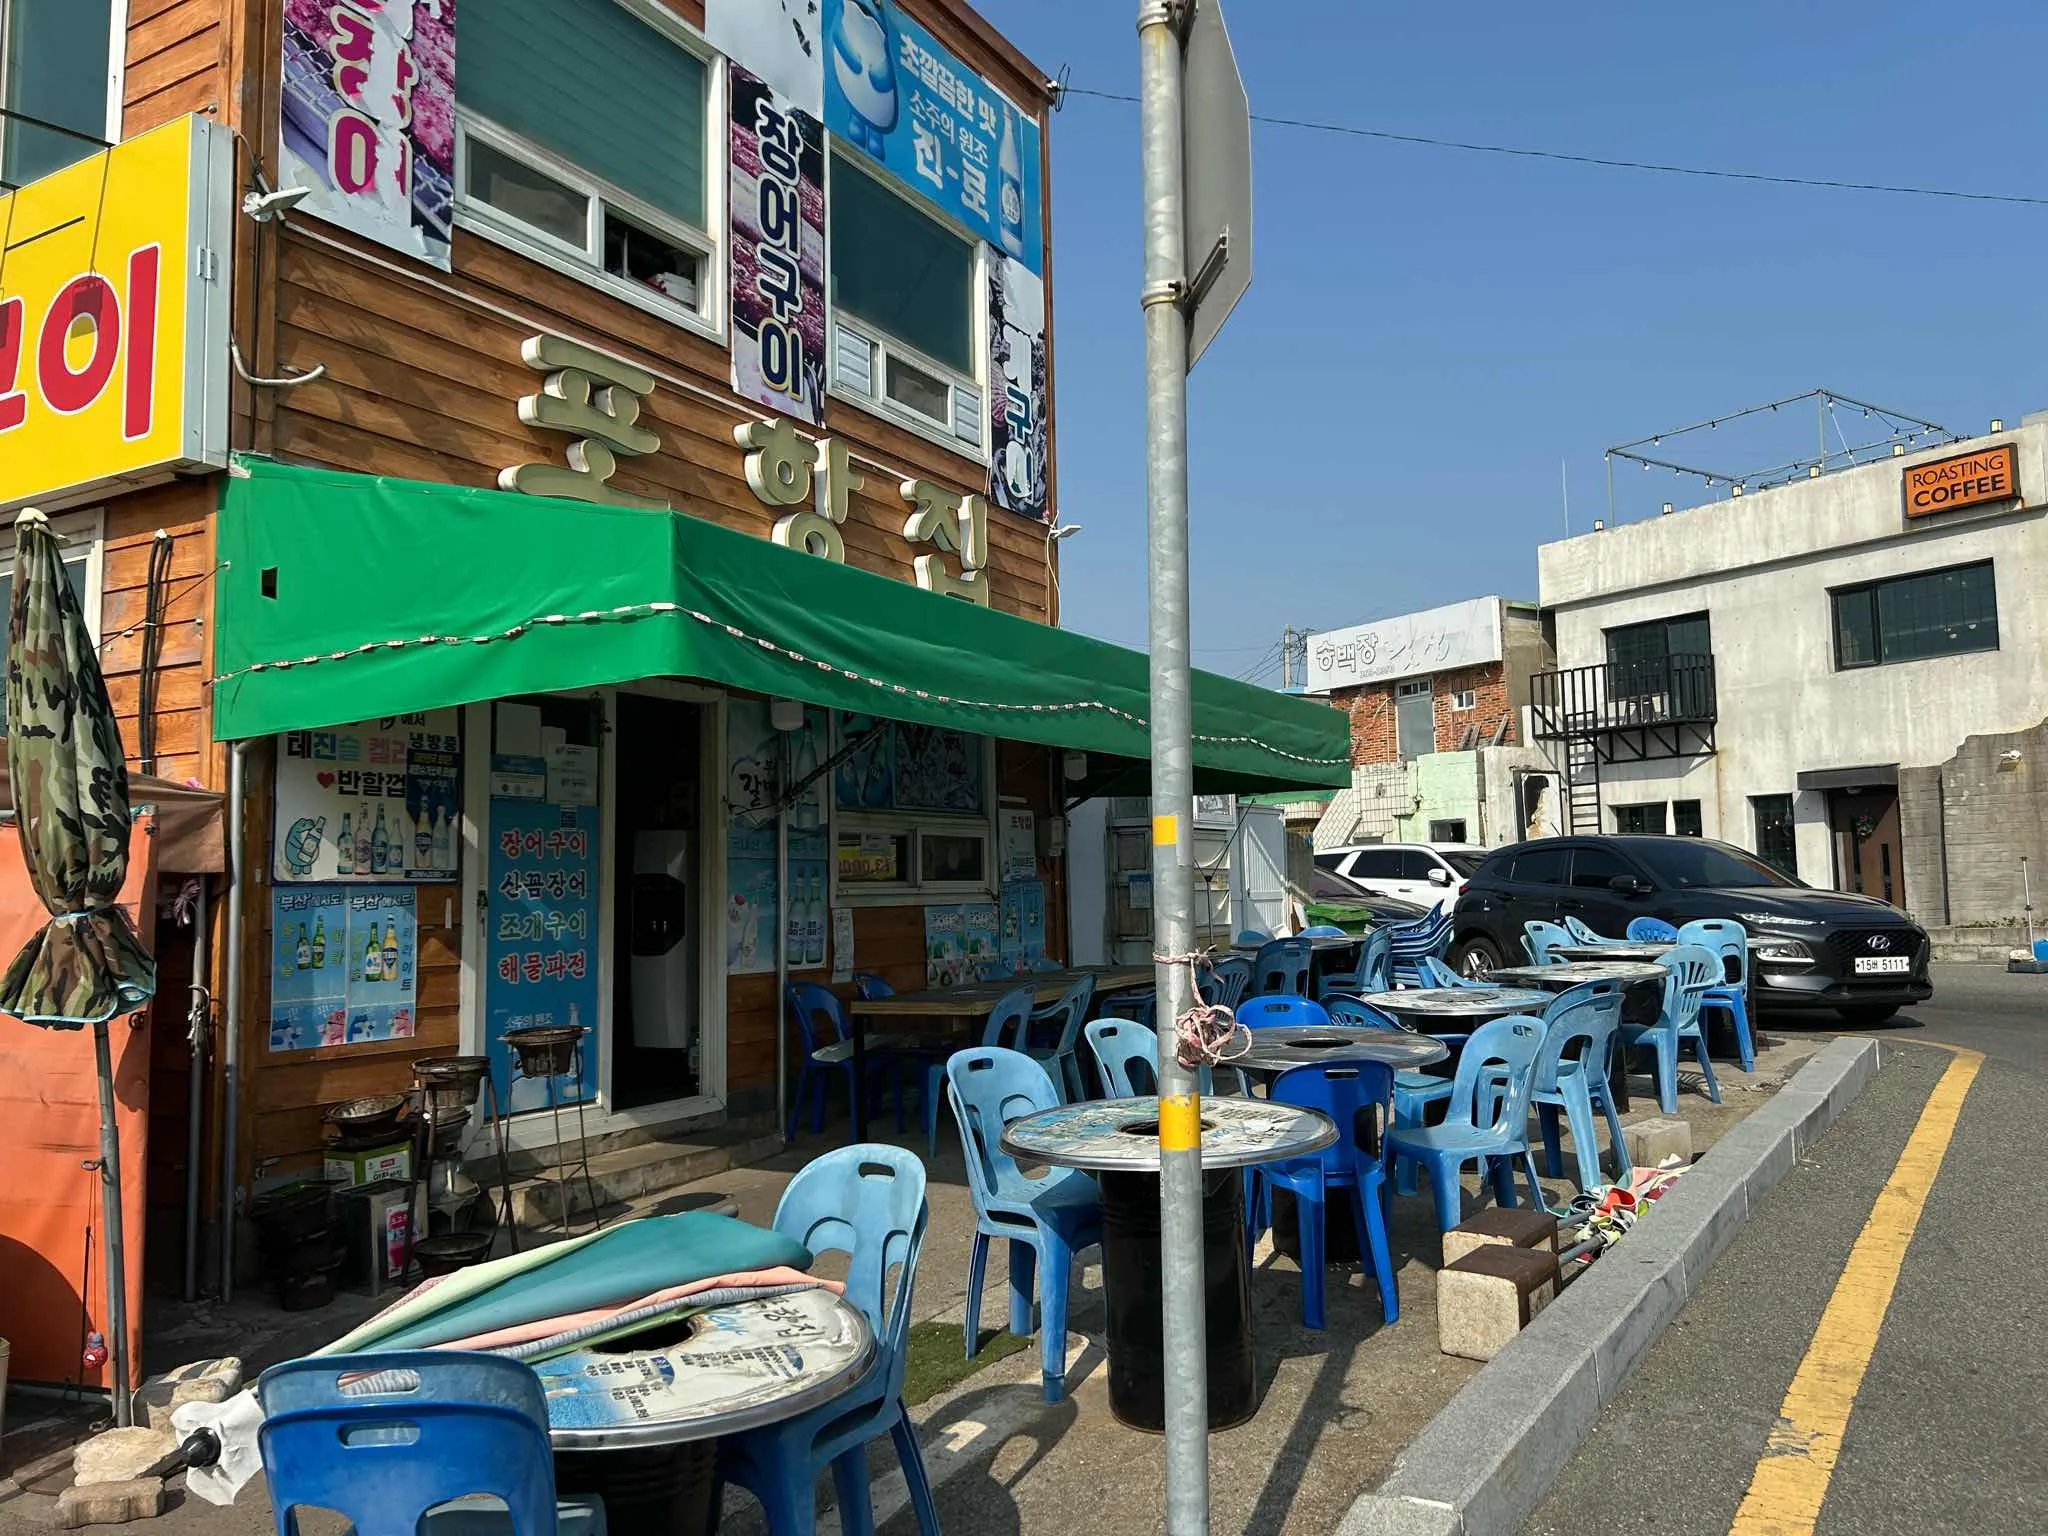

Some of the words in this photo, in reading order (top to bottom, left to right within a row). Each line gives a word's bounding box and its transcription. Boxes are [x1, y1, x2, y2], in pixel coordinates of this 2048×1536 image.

[900, 33, 974, 122] 초깔끔한
[978, 96, 997, 140] 맛
[909, 89, 955, 145] 소주의
[959, 127, 989, 169] 원조
[755, 97, 803, 402] 장어구이
[1912, 455, 2004, 488] ROASTING
[1914, 473, 2006, 507] COFFEE
[1316, 632, 1379, 673] 송백장
[501, 827, 589, 859] 장어구이
[500, 869, 588, 900] 산꼼장어
[497, 909, 588, 942] 조개구이
[499, 949, 587, 985] 해물파전
[1882, 959, 1904, 970] 5111
